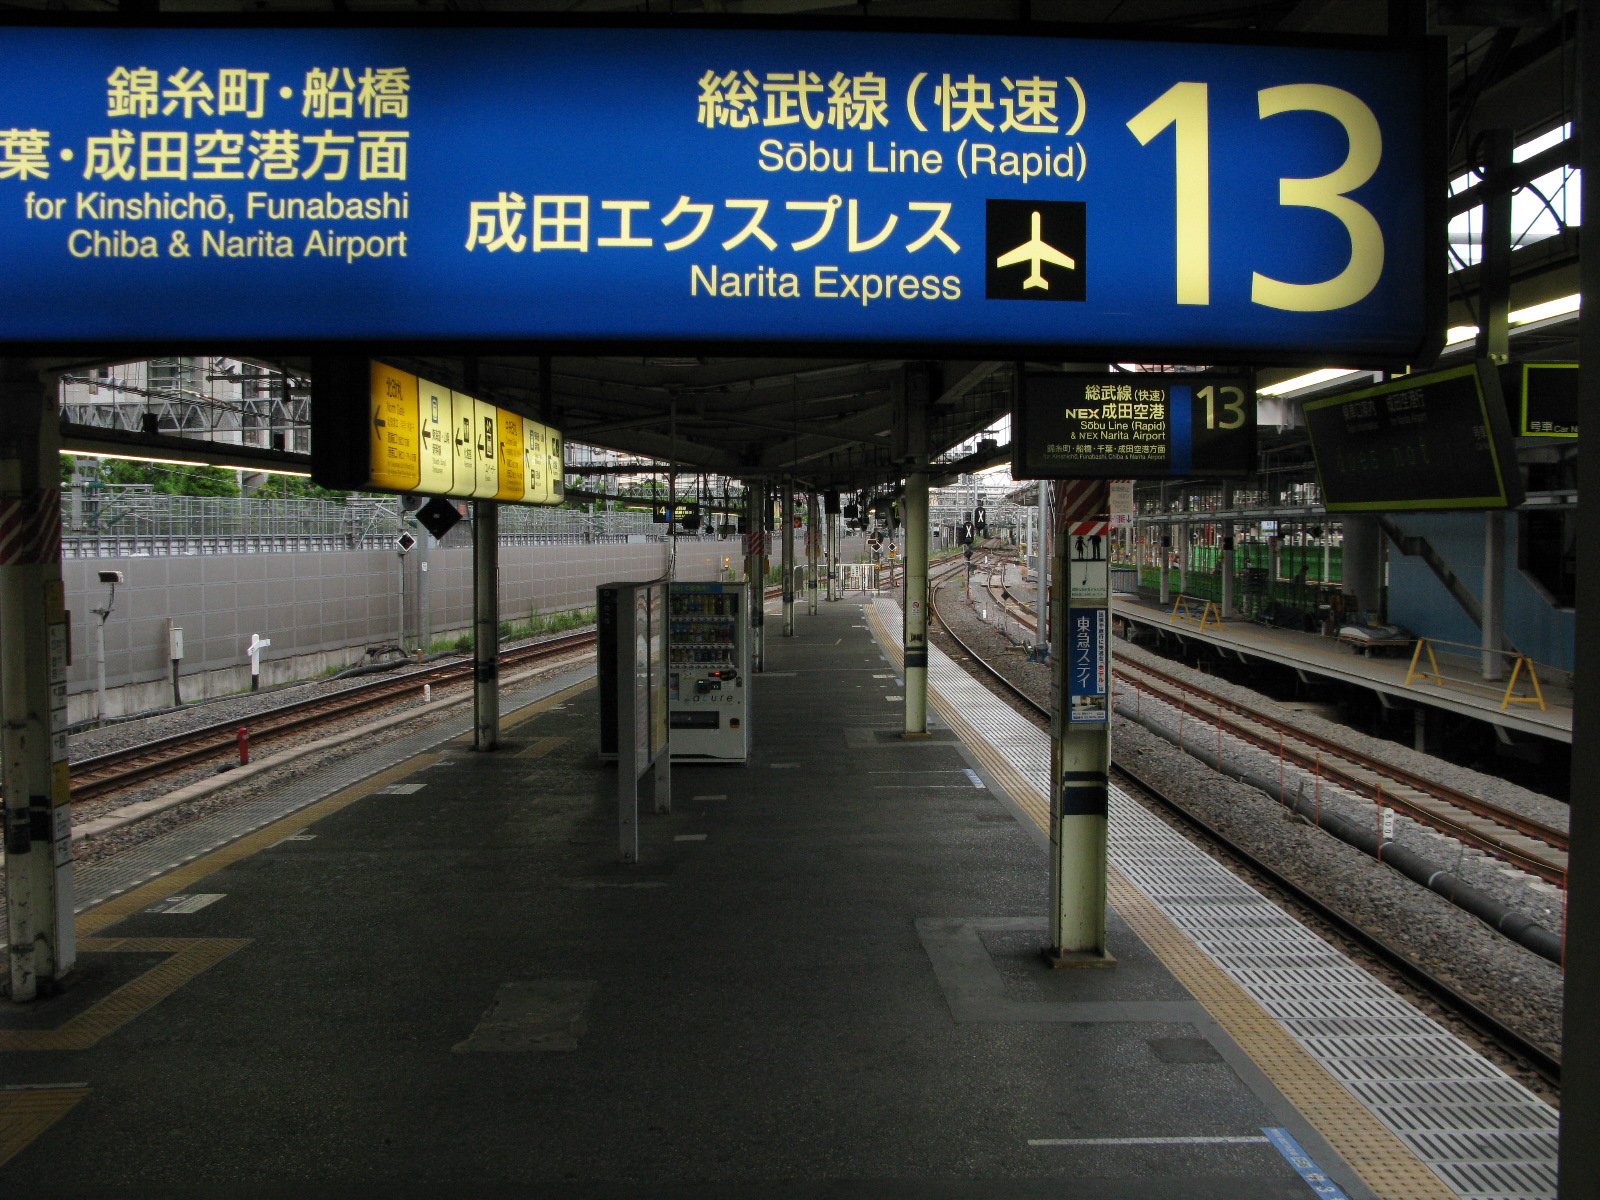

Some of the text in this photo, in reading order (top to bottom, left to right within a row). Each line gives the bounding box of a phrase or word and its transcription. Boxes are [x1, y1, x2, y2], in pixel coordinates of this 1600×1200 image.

[106, 66, 410, 119] 錦糸町・船橋
[697, 69, 1088, 137] 総武線（快速）
[0, 128, 410, 182] 葉・成田空港方面
[758, 138, 1088, 184] Sōbu Line (Rapid)
[24, 191, 410, 224] for Kinshichō, Funabashi
[1125, 81, 1385, 312] 13
[465, 191, 962, 255] 成田エクスプレス
[68, 229, 408, 264] Chiba & Narita Airport
[690, 264, 962, 307] Narita Express
[1085, 385, 1166, 402] 総武線（快速）
[1101, 403, 1165, 420] 成田空港
[1195, 385, 1246, 430] 13
[1070, 432, 1076, 440] &
[1100, 431, 1129, 440] Narita
[1132, 431, 1166, 441] Airport
[1080, 421, 1166, 431] Sōbu Line (Rapid)
[1530, 420, 1553, 432] 号車
[1553, 425, 1569, 433] Car
[1077, 616, 1091, 689] 東急ステイ
